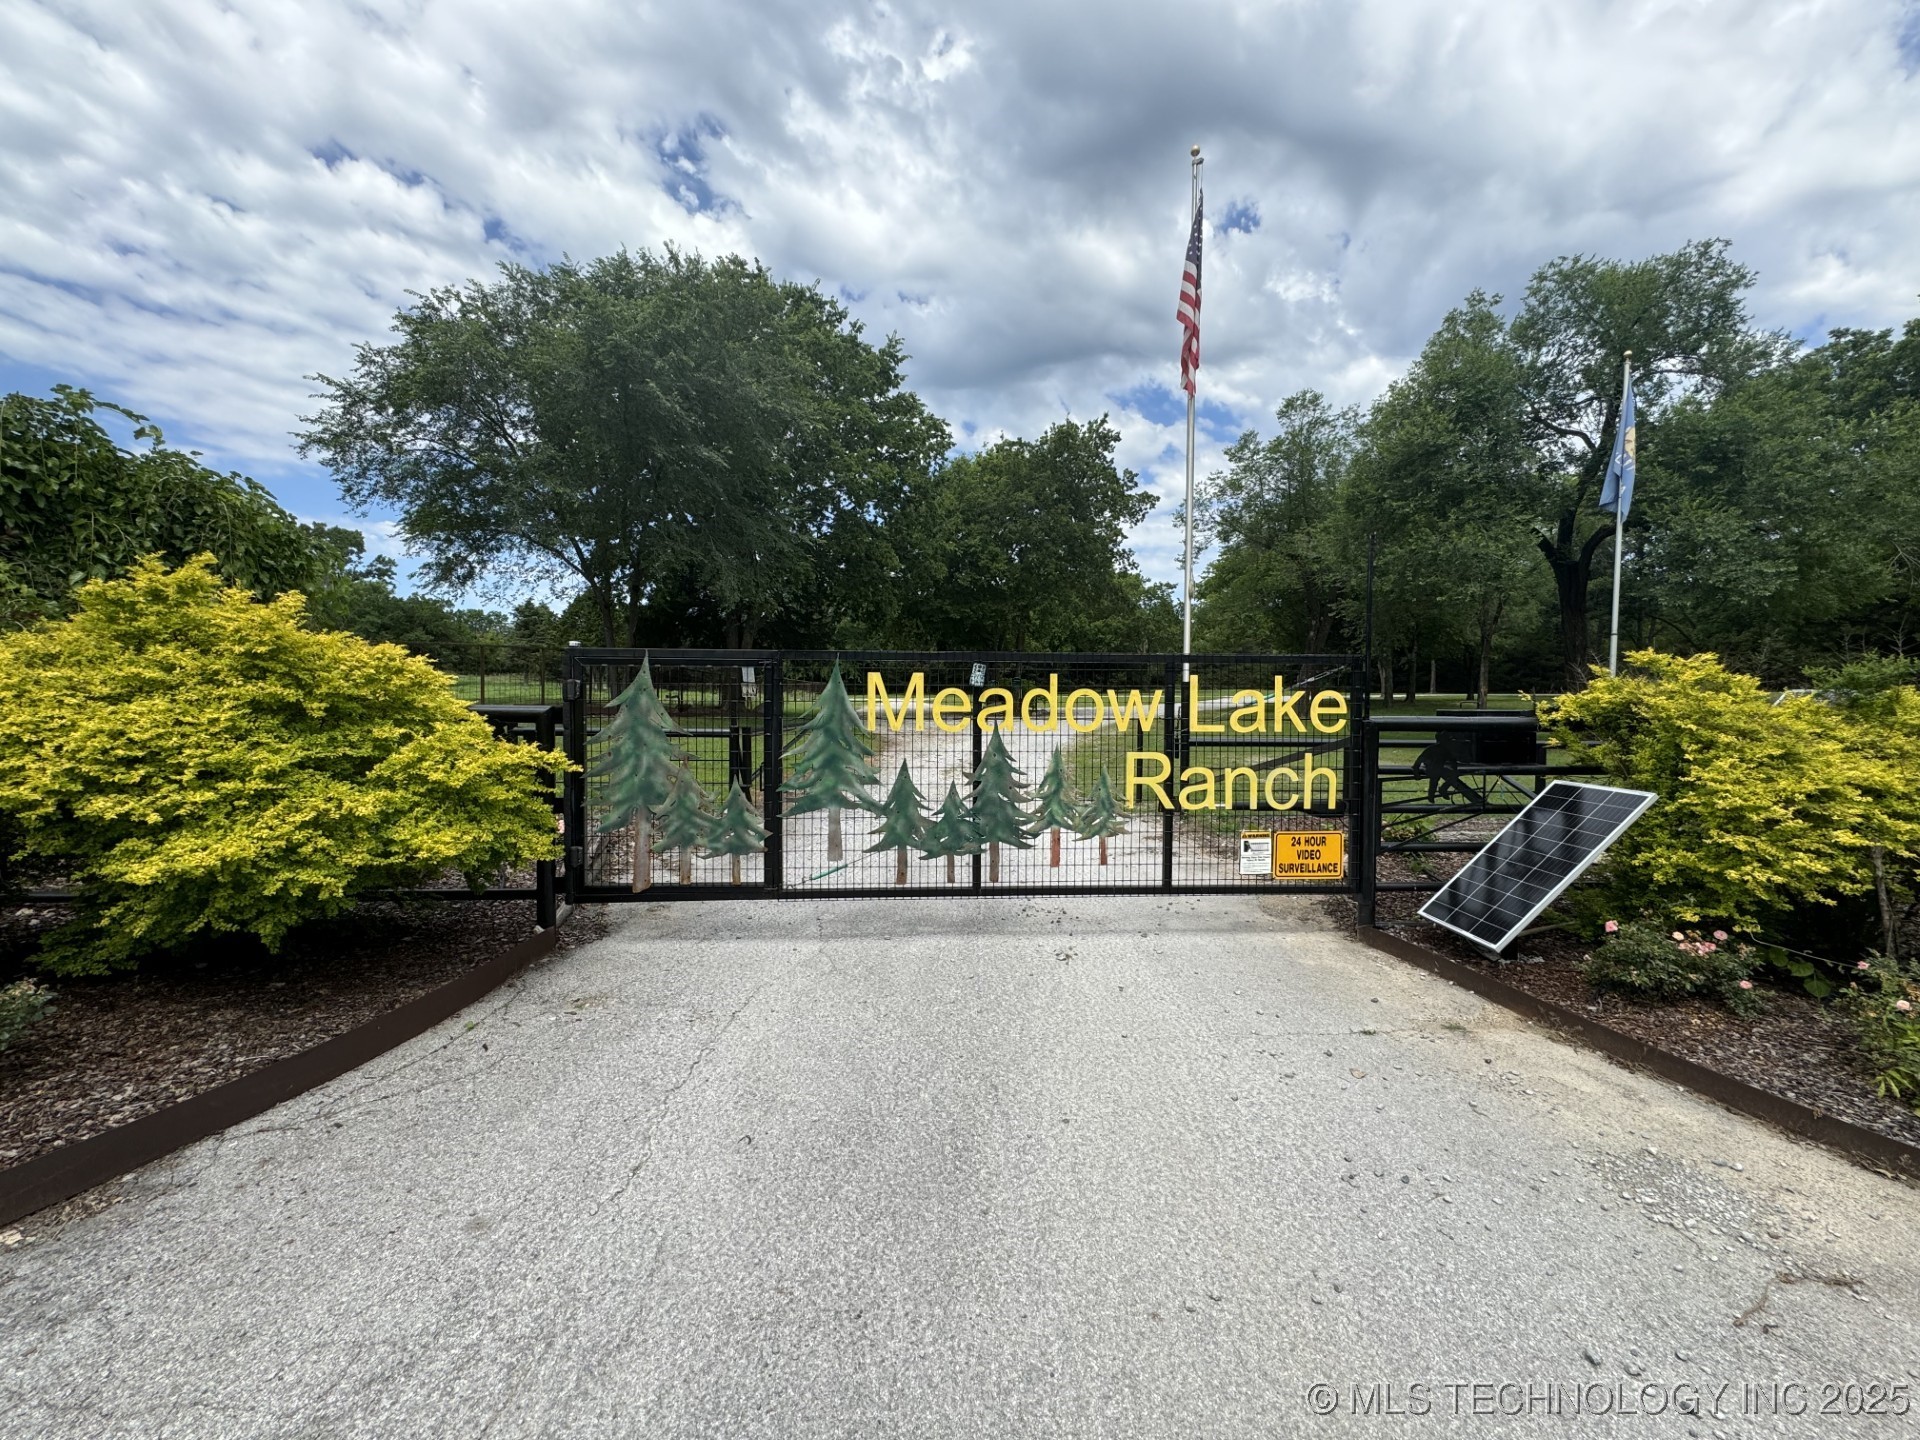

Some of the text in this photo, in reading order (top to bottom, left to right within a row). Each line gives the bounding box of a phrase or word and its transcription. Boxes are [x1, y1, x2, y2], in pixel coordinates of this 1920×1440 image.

[867, 672, 1348, 734] Meadow Lake
[1125, 751, 1337, 810] Ranch
[1291, 836, 1326, 847] 24 HOUR
[1296, 849, 1321, 860] VIDEO
[1278, 862, 1338, 873] SURVEILLANCE
